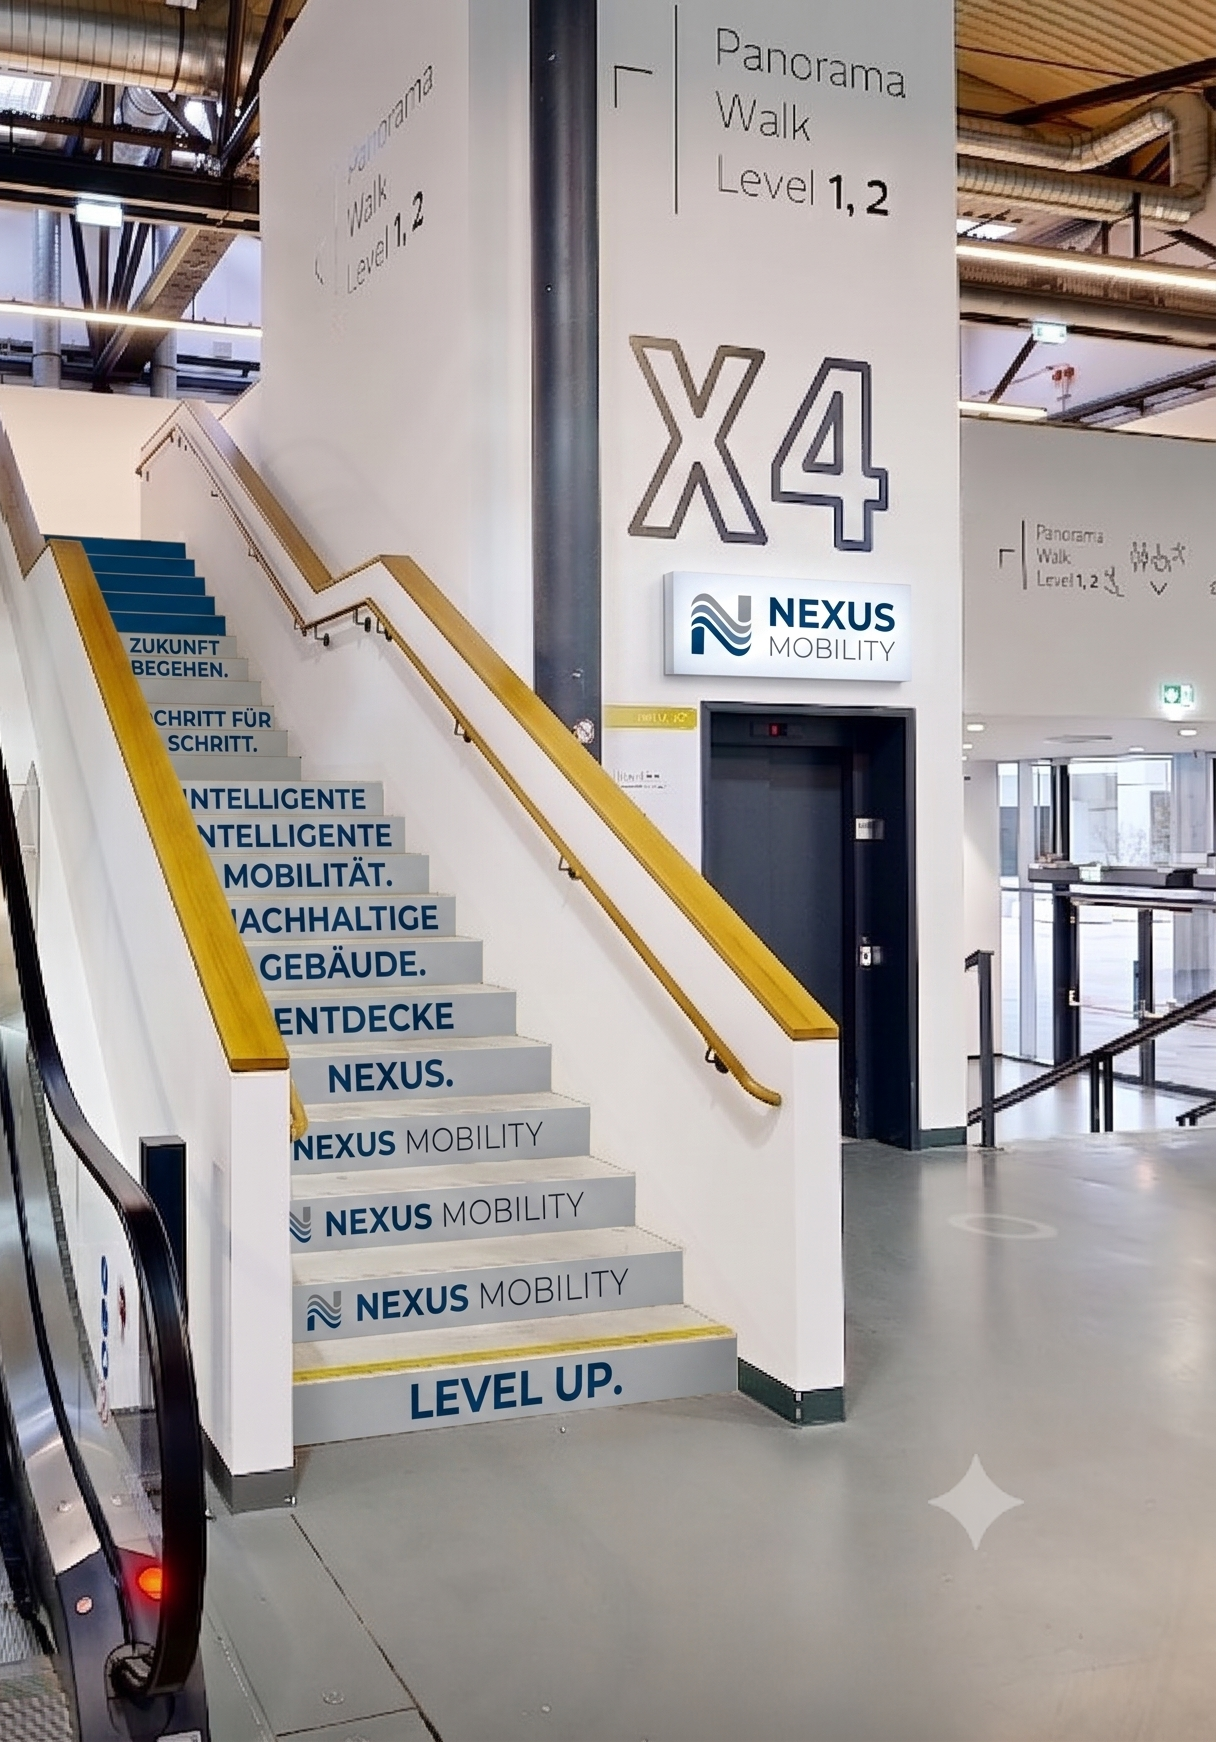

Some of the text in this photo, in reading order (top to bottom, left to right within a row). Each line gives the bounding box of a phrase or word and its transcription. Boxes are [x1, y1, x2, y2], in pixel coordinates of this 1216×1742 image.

[717, 27, 906, 98] Panorama
[715, 90, 810, 142] Walk
[718, 154, 814, 206] Level
[347, 173, 387, 238] Walk
[347, 224, 389, 294] Level
[628, 334, 888, 552] X4
[1036, 523, 1104, 544] Panorama
[1036, 547, 1072, 565] Walk
[1037, 569, 1074, 588] Level
[769, 597, 896, 632] NEXUS
[129, 637, 220, 656] ZUKUNFT
[769, 635, 896, 661] MOBILITY
[131, 660, 228, 678] BEGEHEN.
[150, 707, 272, 728] CHRITT FÜR
[168, 734, 258, 753] SCHRITT.
[224, 856, 393, 889] MOBILITÄT.
[231, 904, 439, 934] ACHHALTIGE
[260, 945, 426, 981] GEBÄUDE.
[274, 1002, 455, 1036] ENTDECKE
[328, 1058, 454, 1094] NEXUS.
[293, 1121, 544, 1161] NEXUS MOBILITY
[326, 1191, 585, 1237] NEXUS MOBILITY
[356, 1283, 469, 1322] NEXUS
[480, 1268, 630, 1310] MOBILITY
[410, 1361, 623, 1420] LEVEL UP.
